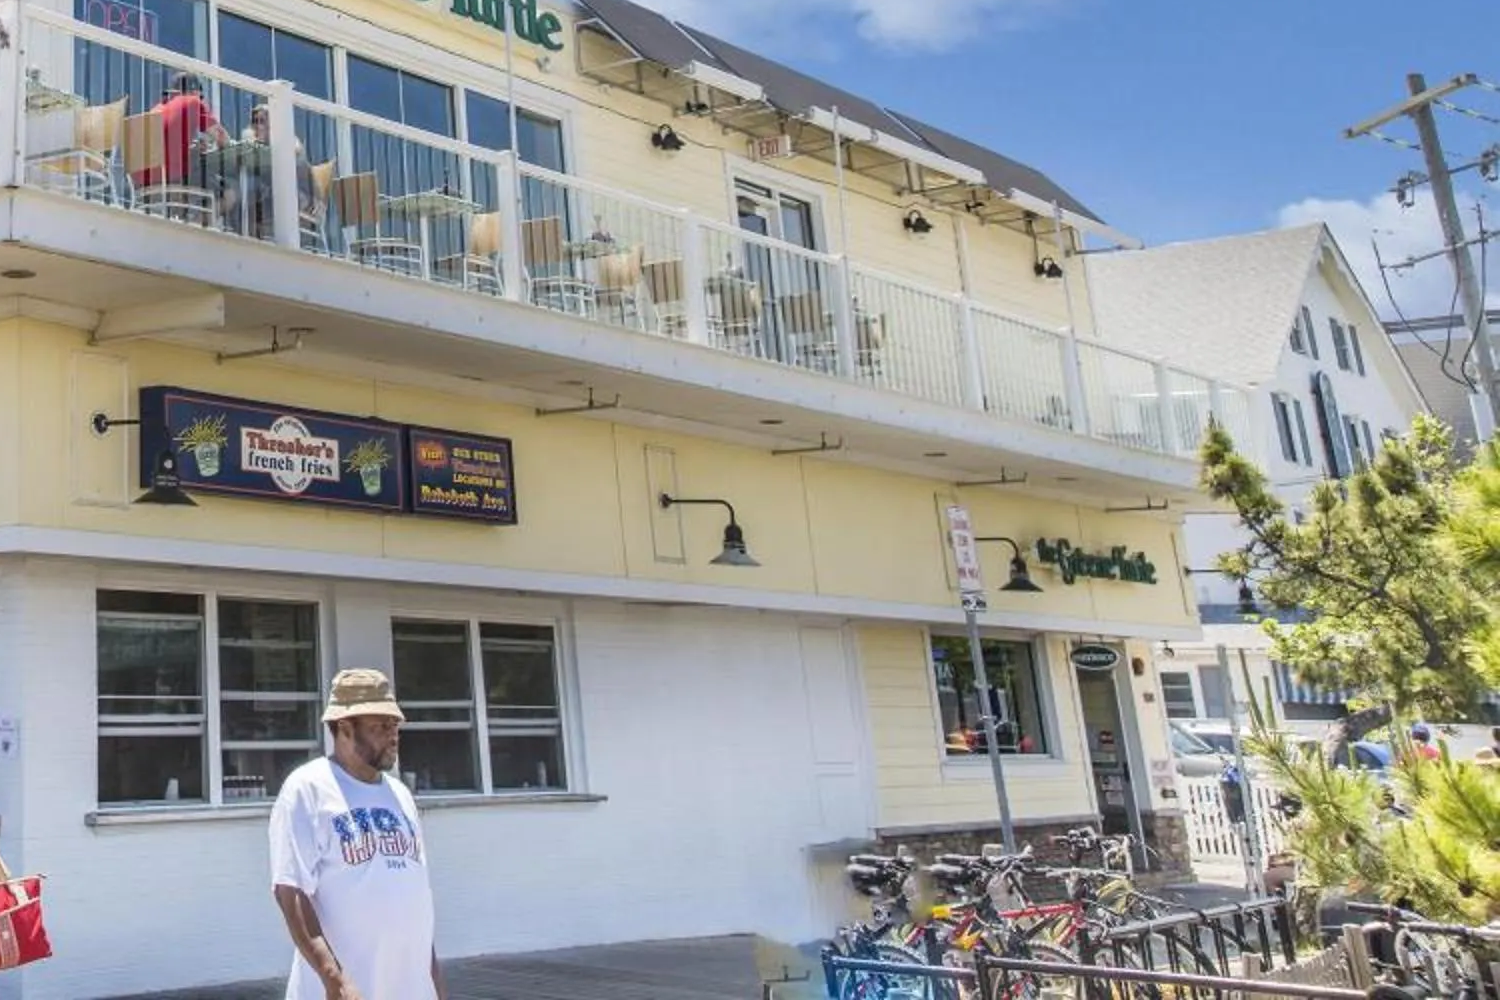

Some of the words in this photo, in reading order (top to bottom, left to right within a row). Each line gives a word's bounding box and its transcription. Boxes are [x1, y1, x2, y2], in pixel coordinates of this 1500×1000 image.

[246, 431, 334, 459] Thrasher's
[249, 453, 294, 472] french
[301, 459, 332, 476] fries
